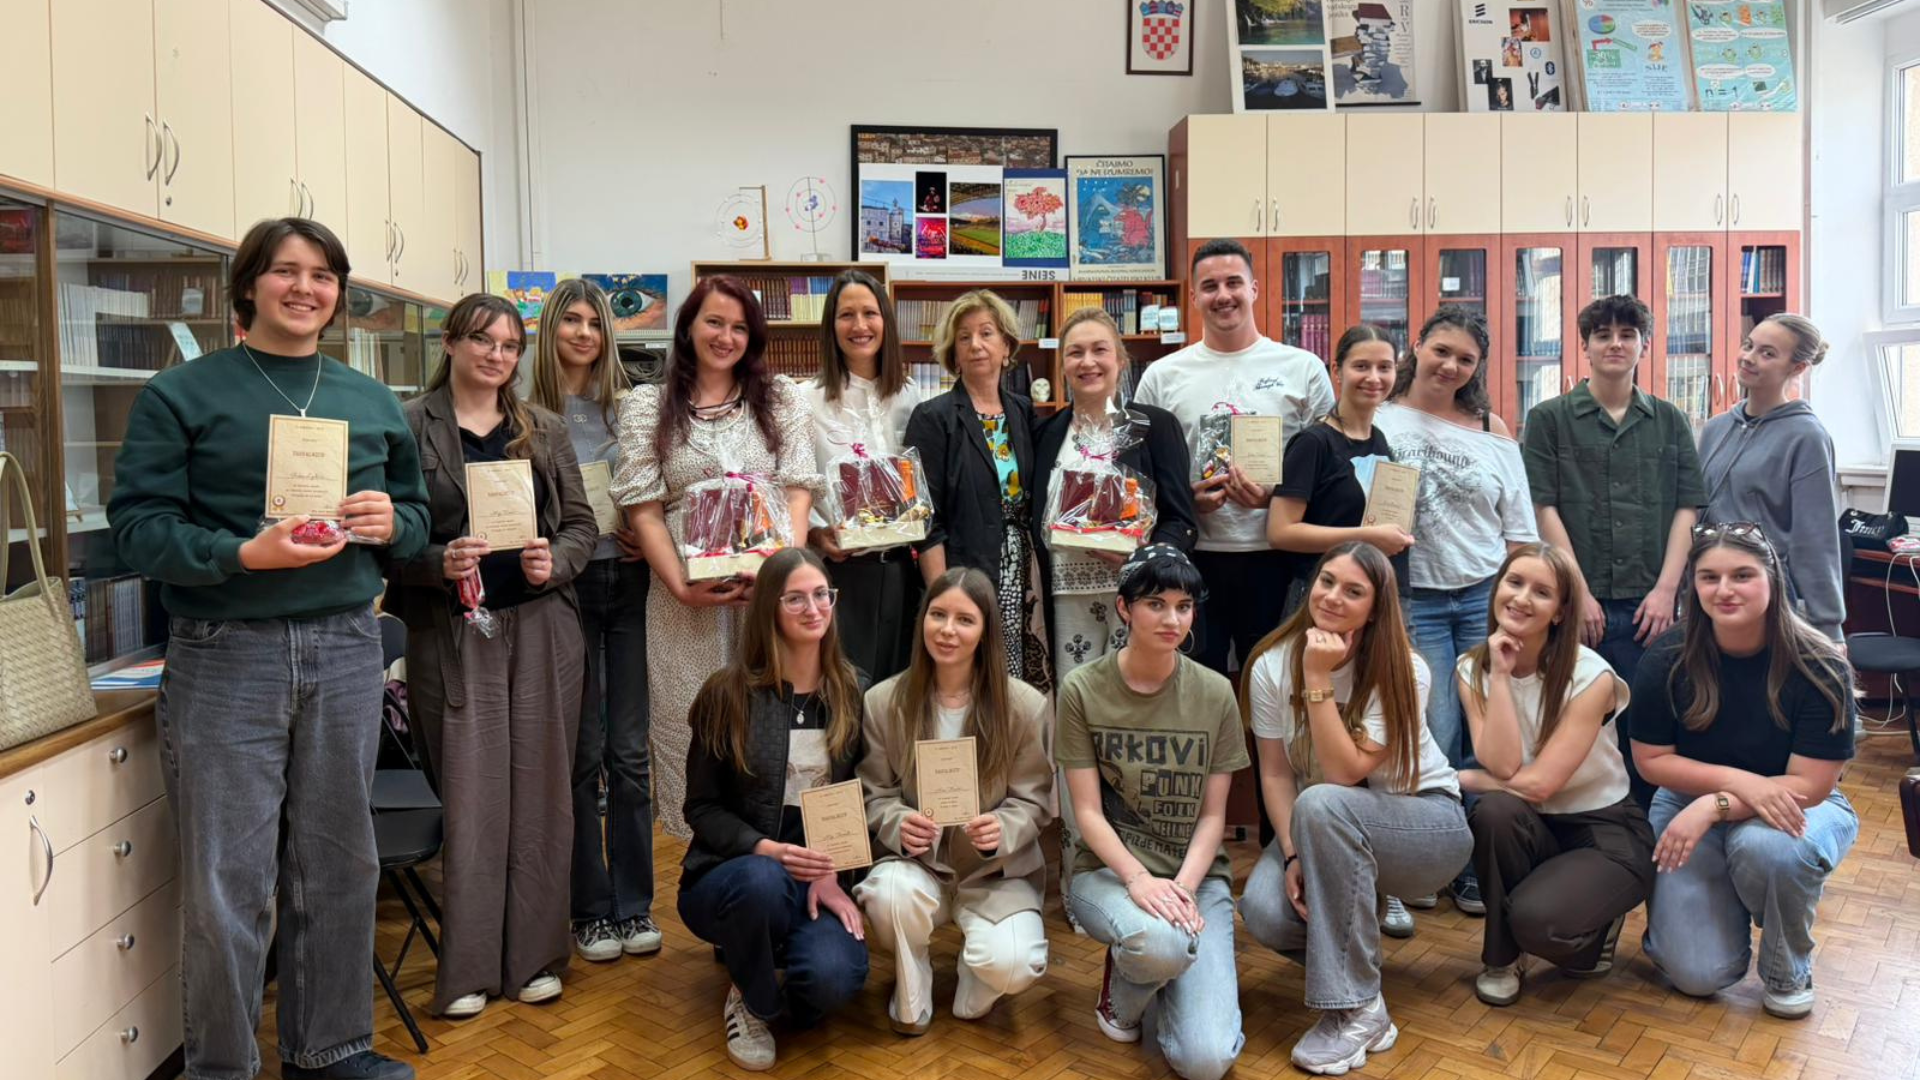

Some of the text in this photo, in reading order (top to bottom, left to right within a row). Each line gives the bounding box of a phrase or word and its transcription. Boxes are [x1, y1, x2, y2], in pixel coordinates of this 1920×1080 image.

[1021, 269, 1056, 280] SEINE
[1140, 769, 1203, 799] PUNK
[1153, 800, 1196, 817] FOLK
